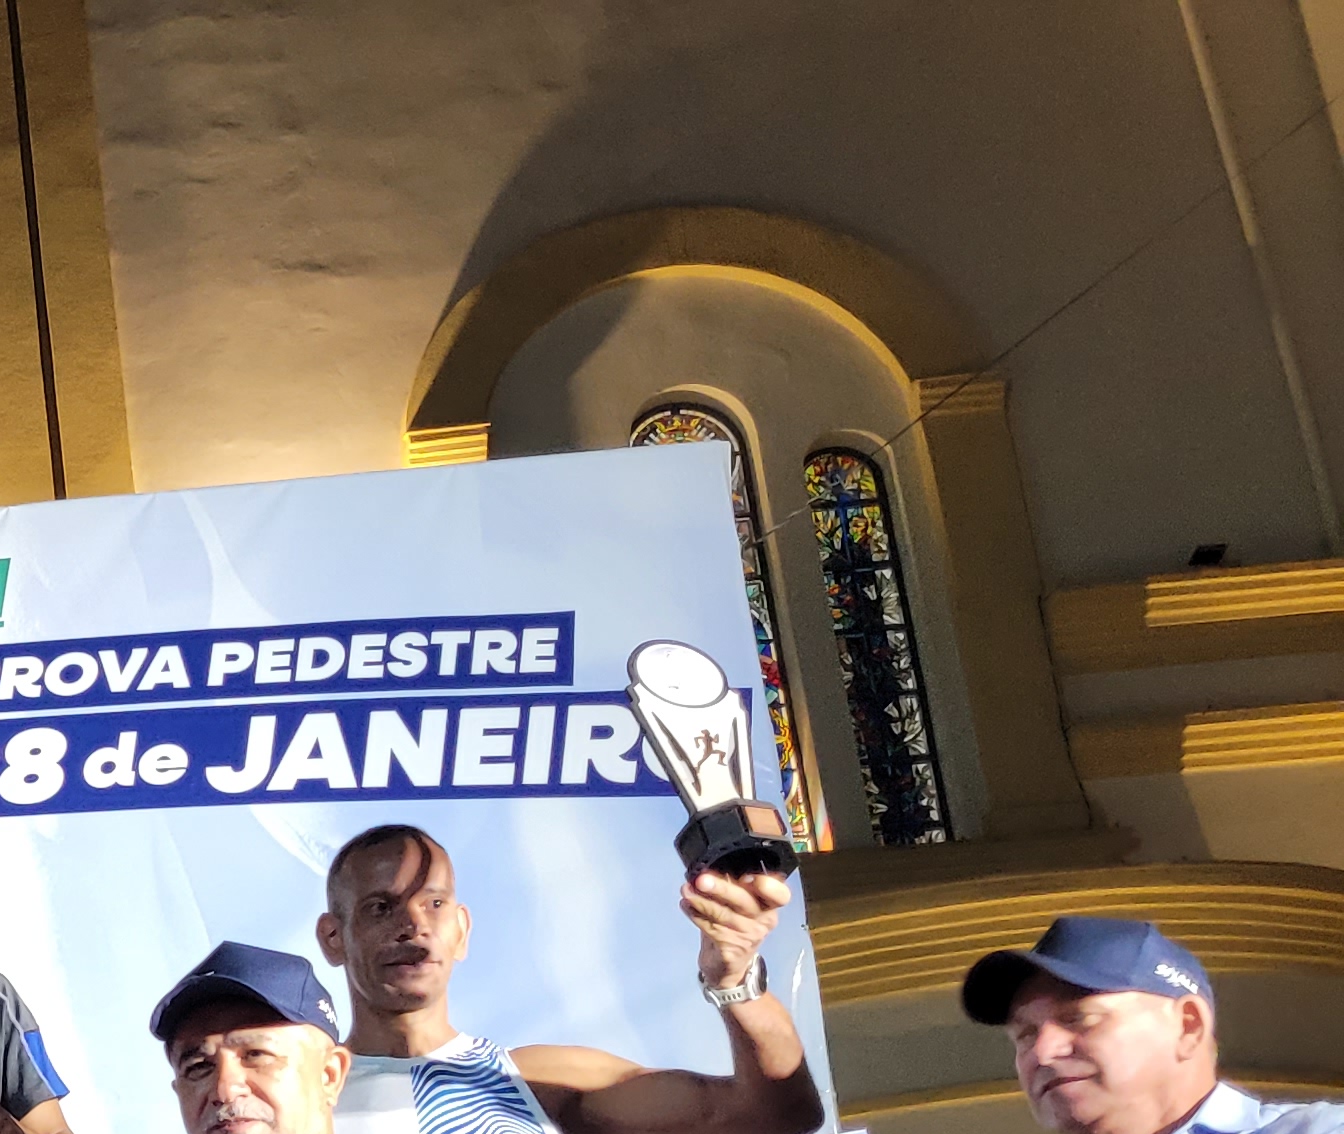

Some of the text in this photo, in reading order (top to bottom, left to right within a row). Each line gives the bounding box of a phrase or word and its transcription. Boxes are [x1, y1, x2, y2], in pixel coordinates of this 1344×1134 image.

[206, 627, 560, 688] PEDESTRE
[82, 730, 189, 790] de
[204, 704, 672, 795] JANEIR
